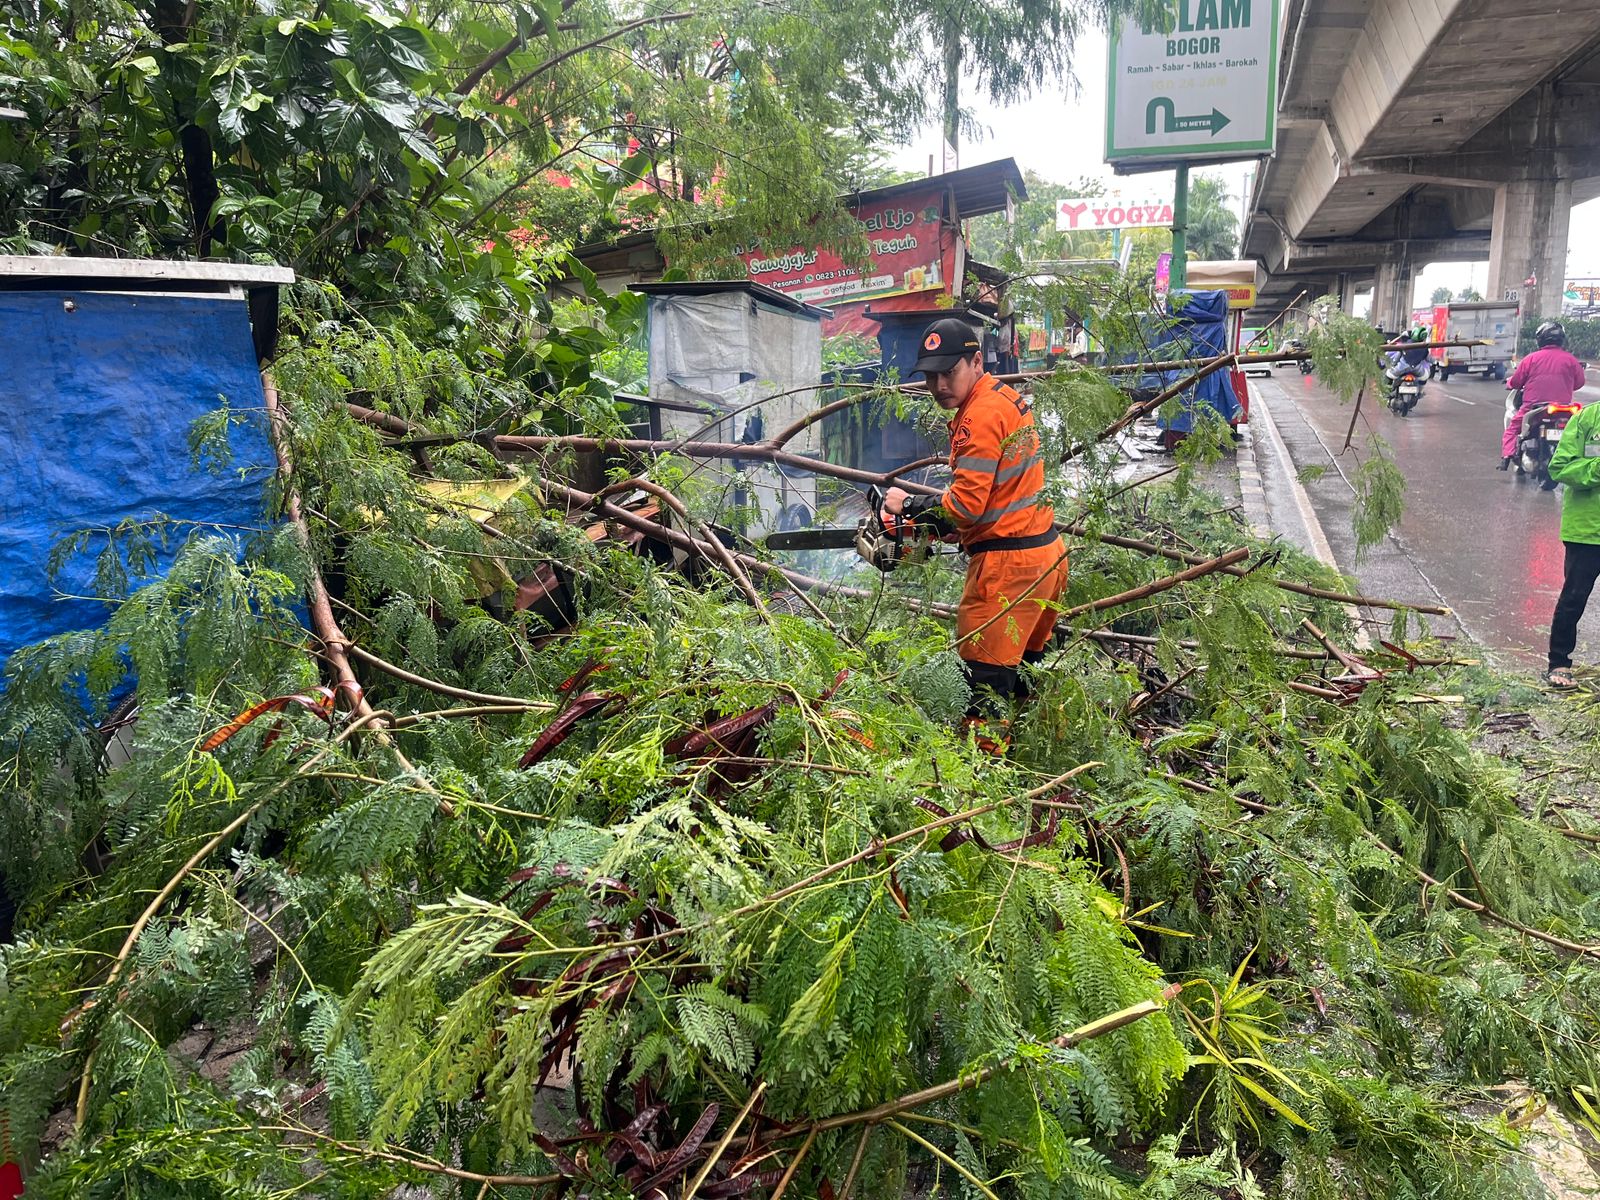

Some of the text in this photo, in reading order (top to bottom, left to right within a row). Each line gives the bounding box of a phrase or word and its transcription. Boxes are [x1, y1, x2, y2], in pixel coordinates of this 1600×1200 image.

[1166, 37, 1221, 57] BOGOR
[1127, 65, 1153, 74] Ramah
[1162, 63, 1184, 72] Sabar
[1193, 61, 1217, 70] Ikhlas
[1225, 58, 1258, 68] Barokah
[885, 208, 915, 230] Ijo
[1092, 205, 1174, 226] YOGYA
[873, 234, 918, 255] Teguh
[750, 250, 819, 274] Sawojajar
[773, 278, 803, 289] Pesanan:
[815, 272, 835, 281] 0823
[830, 283, 856, 295] gofood
